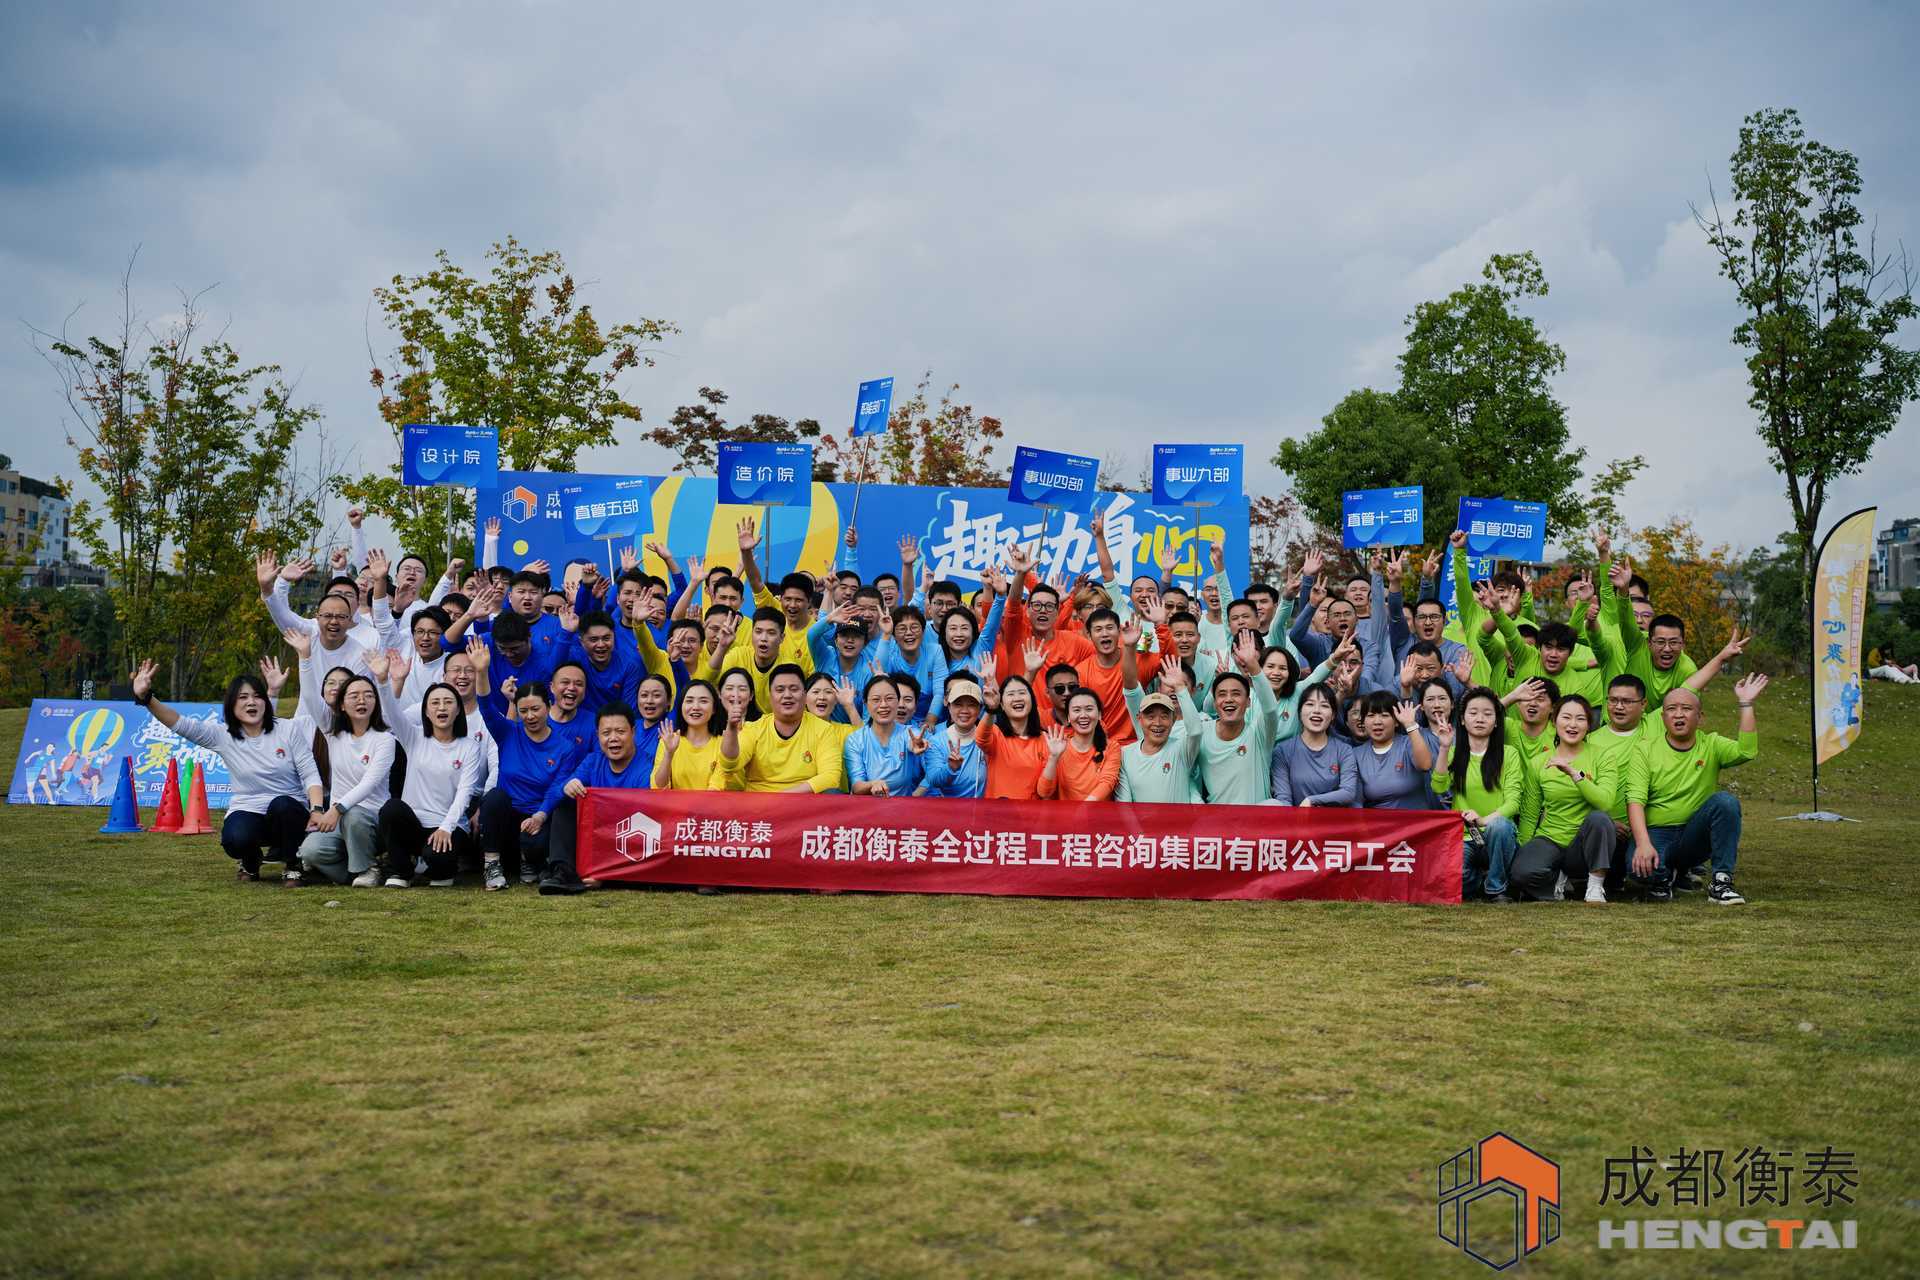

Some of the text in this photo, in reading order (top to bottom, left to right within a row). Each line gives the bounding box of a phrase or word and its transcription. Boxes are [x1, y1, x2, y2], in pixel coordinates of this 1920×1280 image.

[421, 448, 481, 465] 设计院
[735, 466, 795, 483] 造价院
[1023, 469, 1084, 492] 事业四部
[1165, 467, 1229, 482] 事业九部
[573, 499, 639, 520] 直管五部
[1347, 508, 1418, 527] 直管十二部
[1470, 520, 1533, 539] 直管四部
[674, 818, 773, 844] 成都衡泰
[673, 845, 771, 859] HENGTAI
[799, 825, 1417, 875] 成都衡泰全过程工程咨询集团有限公司工会
